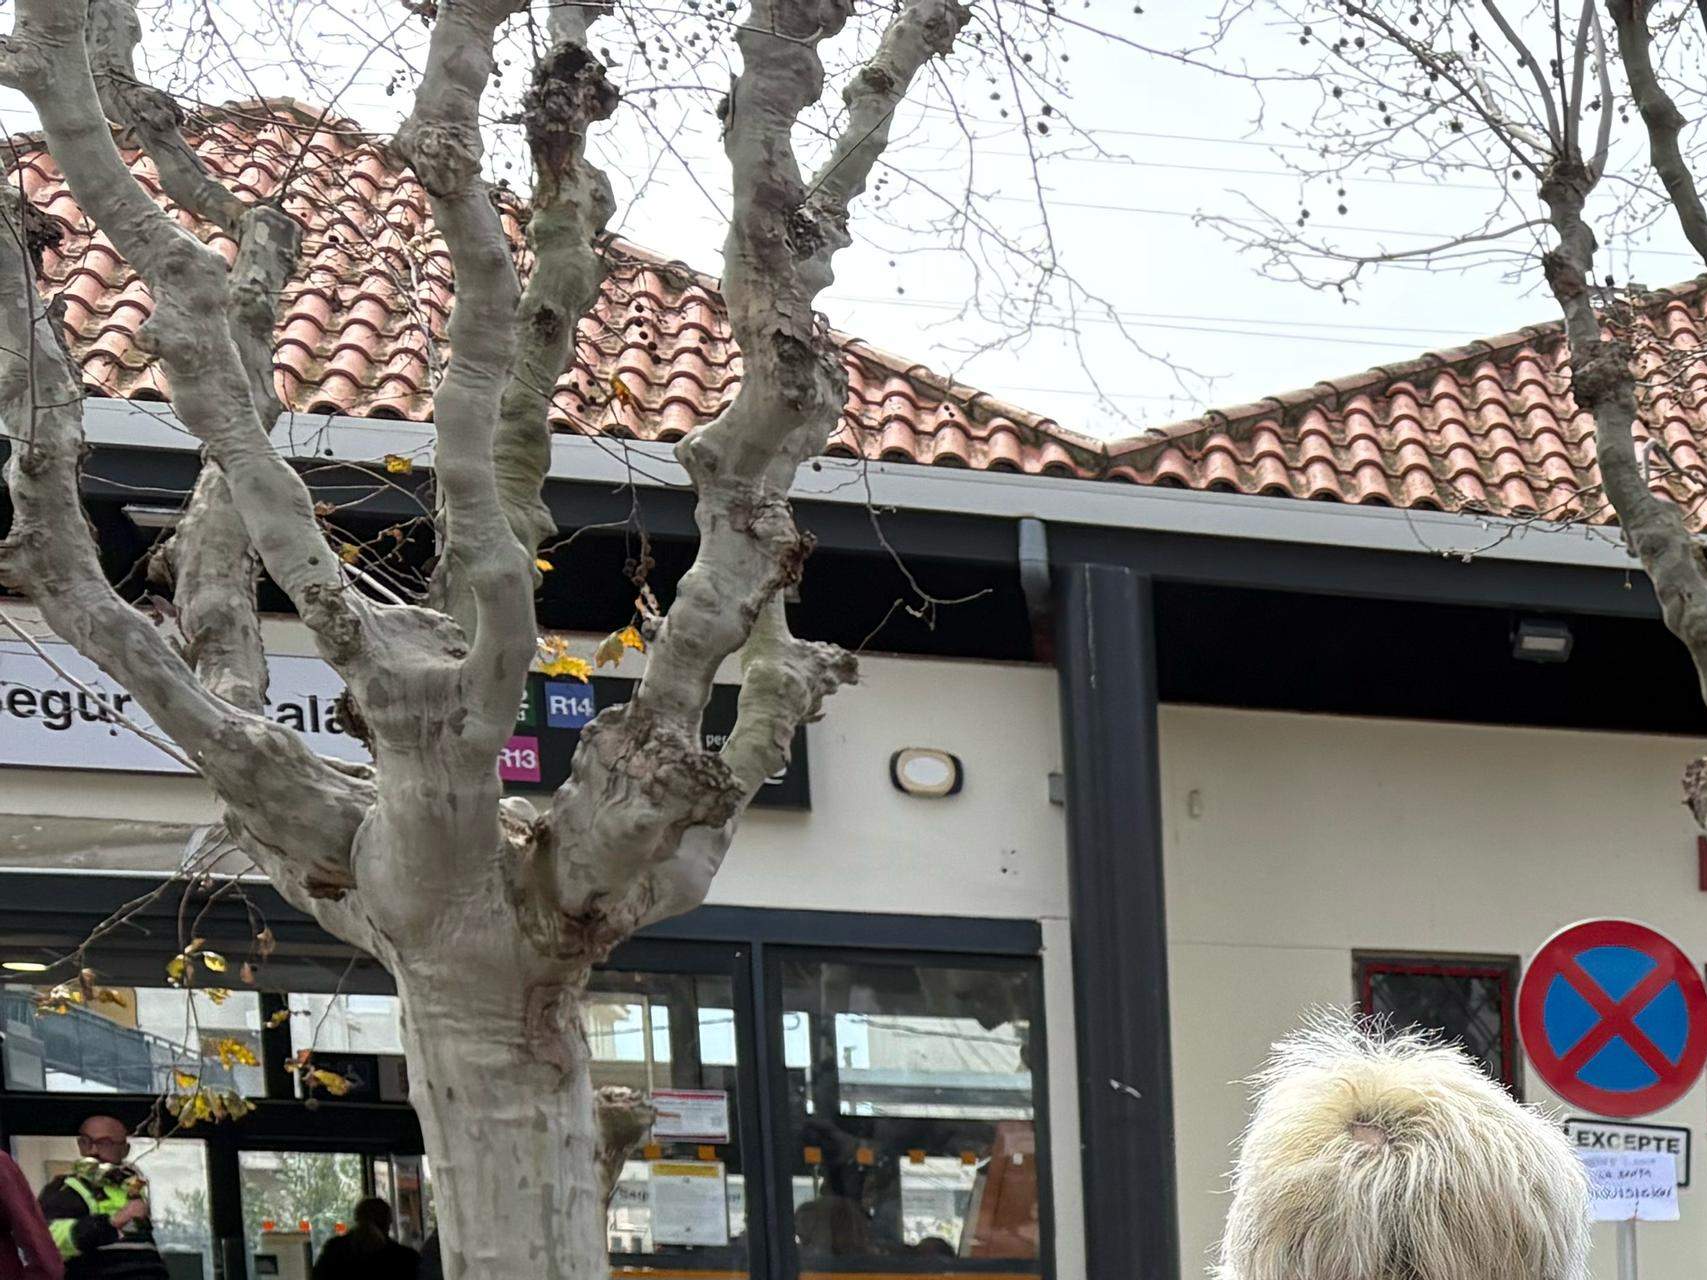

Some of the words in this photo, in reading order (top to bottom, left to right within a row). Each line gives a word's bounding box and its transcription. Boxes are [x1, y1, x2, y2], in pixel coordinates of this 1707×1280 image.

[0, 687, 131, 731] egur
[549, 695, 592, 717] R14
[1577, 1131, 1680, 1154] EXCEPTE
